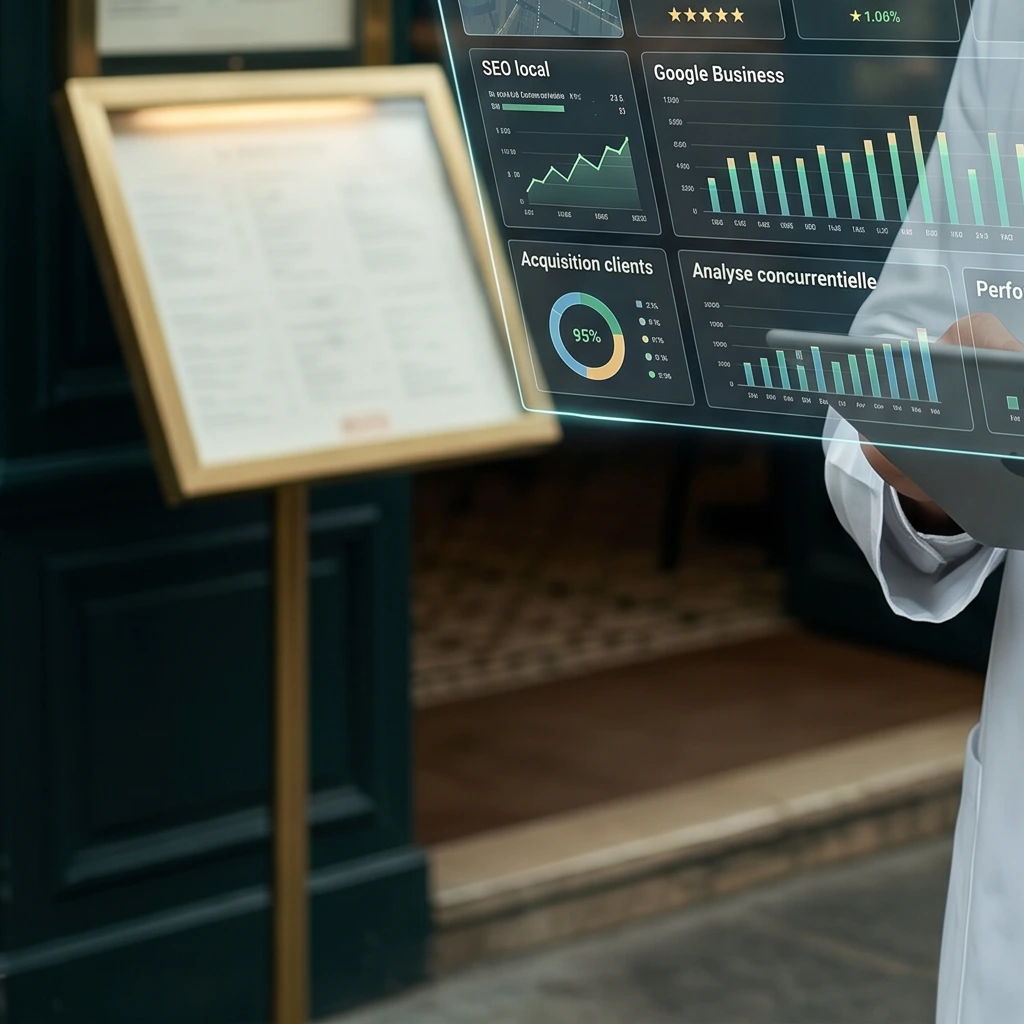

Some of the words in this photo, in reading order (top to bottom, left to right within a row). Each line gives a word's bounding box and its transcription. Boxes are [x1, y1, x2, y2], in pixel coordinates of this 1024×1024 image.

[482, 60, 511, 76] SEO
[514, 60, 550, 77] local
[653, 64, 709, 85] Google
[712, 65, 785, 83] Business
[521, 251, 600, 272] Acquisition
[604, 255, 653, 275] clients
[692, 262, 753, 284] Analyse
[757, 268, 877, 290] concurrentielle
[572, 328, 602, 343] 95%
